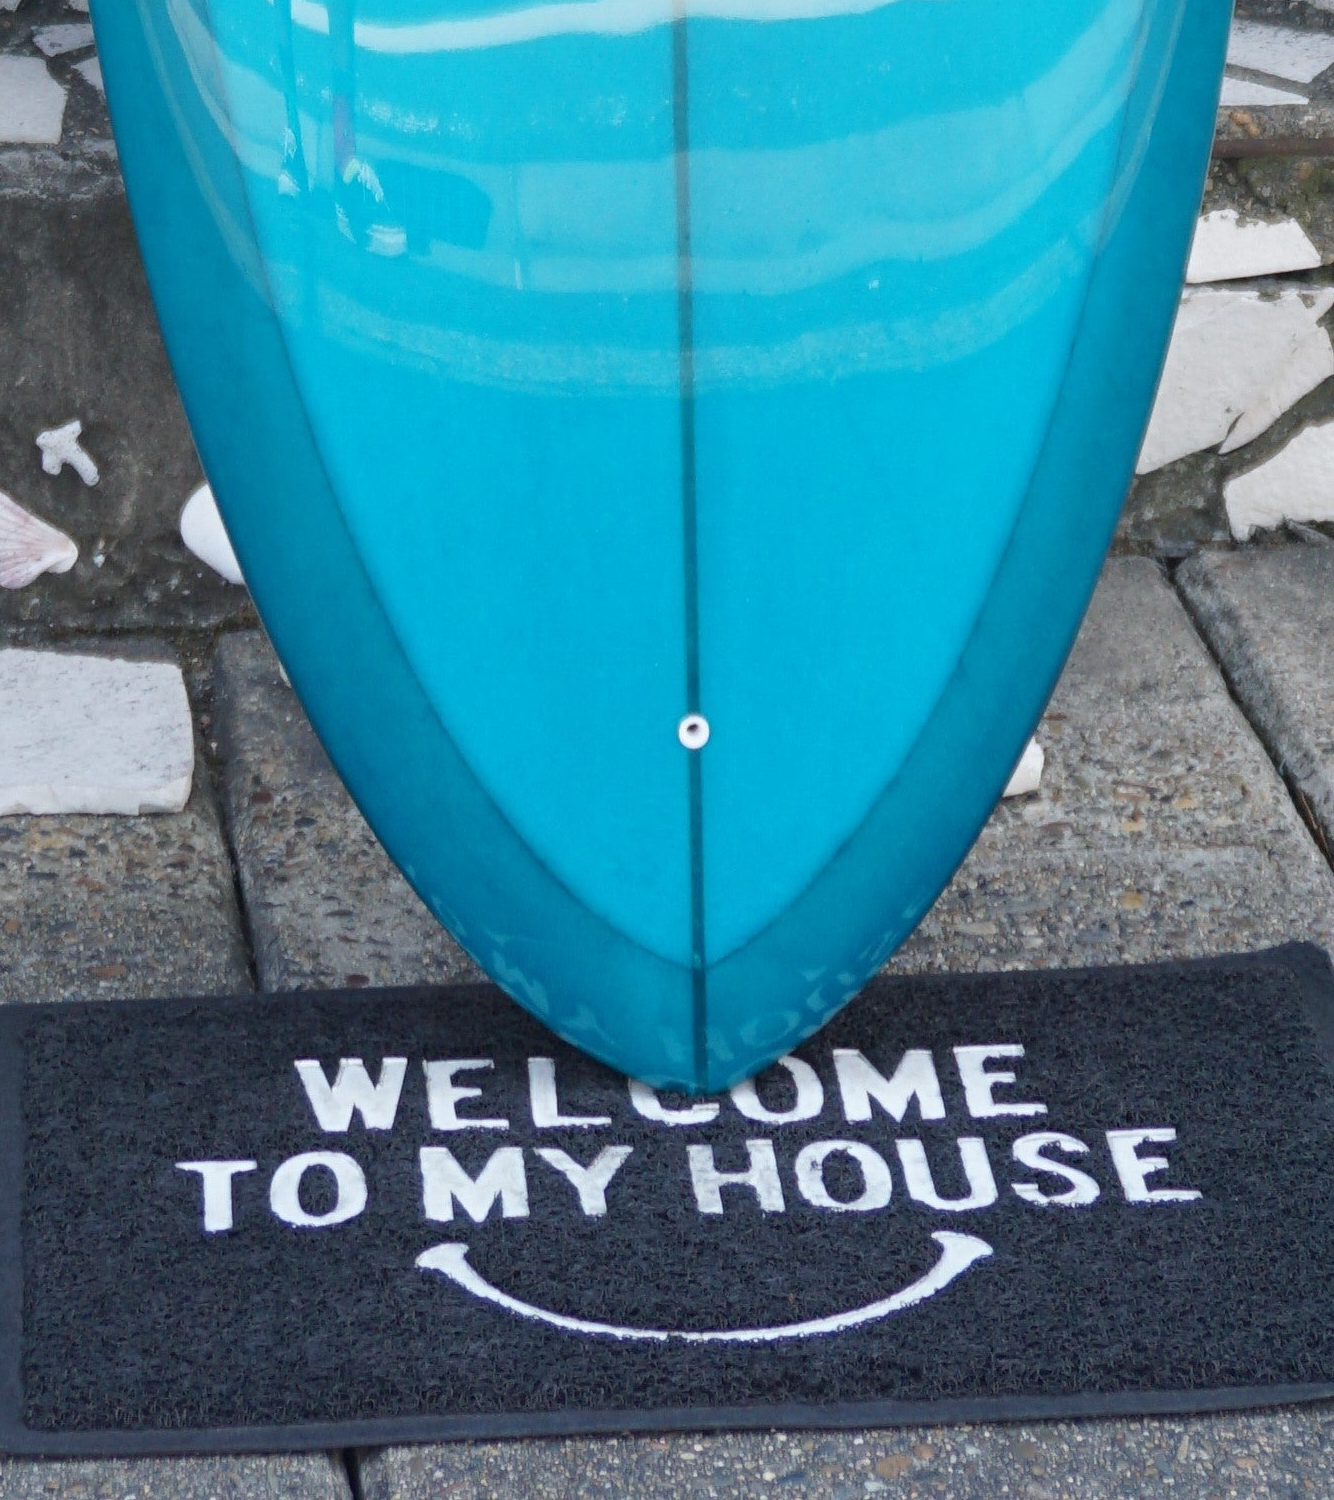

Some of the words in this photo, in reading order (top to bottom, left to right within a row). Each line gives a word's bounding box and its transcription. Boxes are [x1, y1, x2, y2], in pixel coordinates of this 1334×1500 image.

[175, 1150, 369, 1233] TO
[418, 1145, 634, 1223] MY
[686, 1126, 1204, 1215] HOUSE
